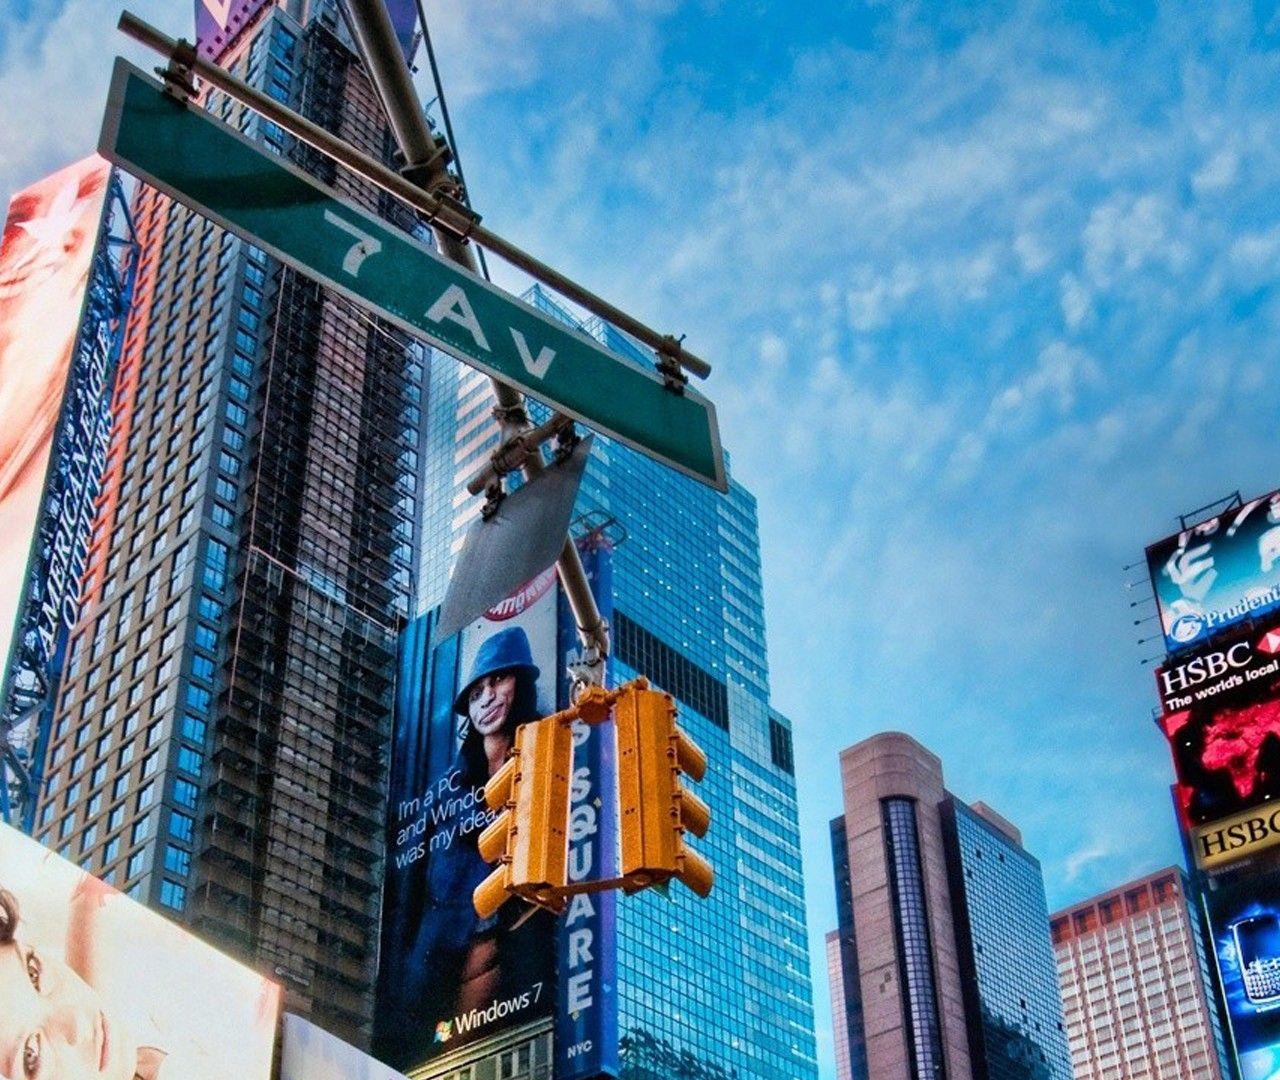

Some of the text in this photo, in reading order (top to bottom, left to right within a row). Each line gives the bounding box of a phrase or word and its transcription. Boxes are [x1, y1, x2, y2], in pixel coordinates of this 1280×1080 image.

[324, 209, 382, 279] 7
[40, 321, 110, 662] AMERICAN EAGLE
[1160, 641, 1253, 696] HSBC
[1166, 694, 1193, 711] The
[1195, 674, 1245, 702] world's
[1246, 659, 1279, 682] local
[424, 790, 435, 804] a
[438, 769, 461, 800] PC
[396, 784, 486, 846] and Windo
[395, 840, 425, 869] was
[429, 827, 456, 856] my
[455, 983, 543, 1035] Windows 7
[567, 1039, 593, 1059] NYC
